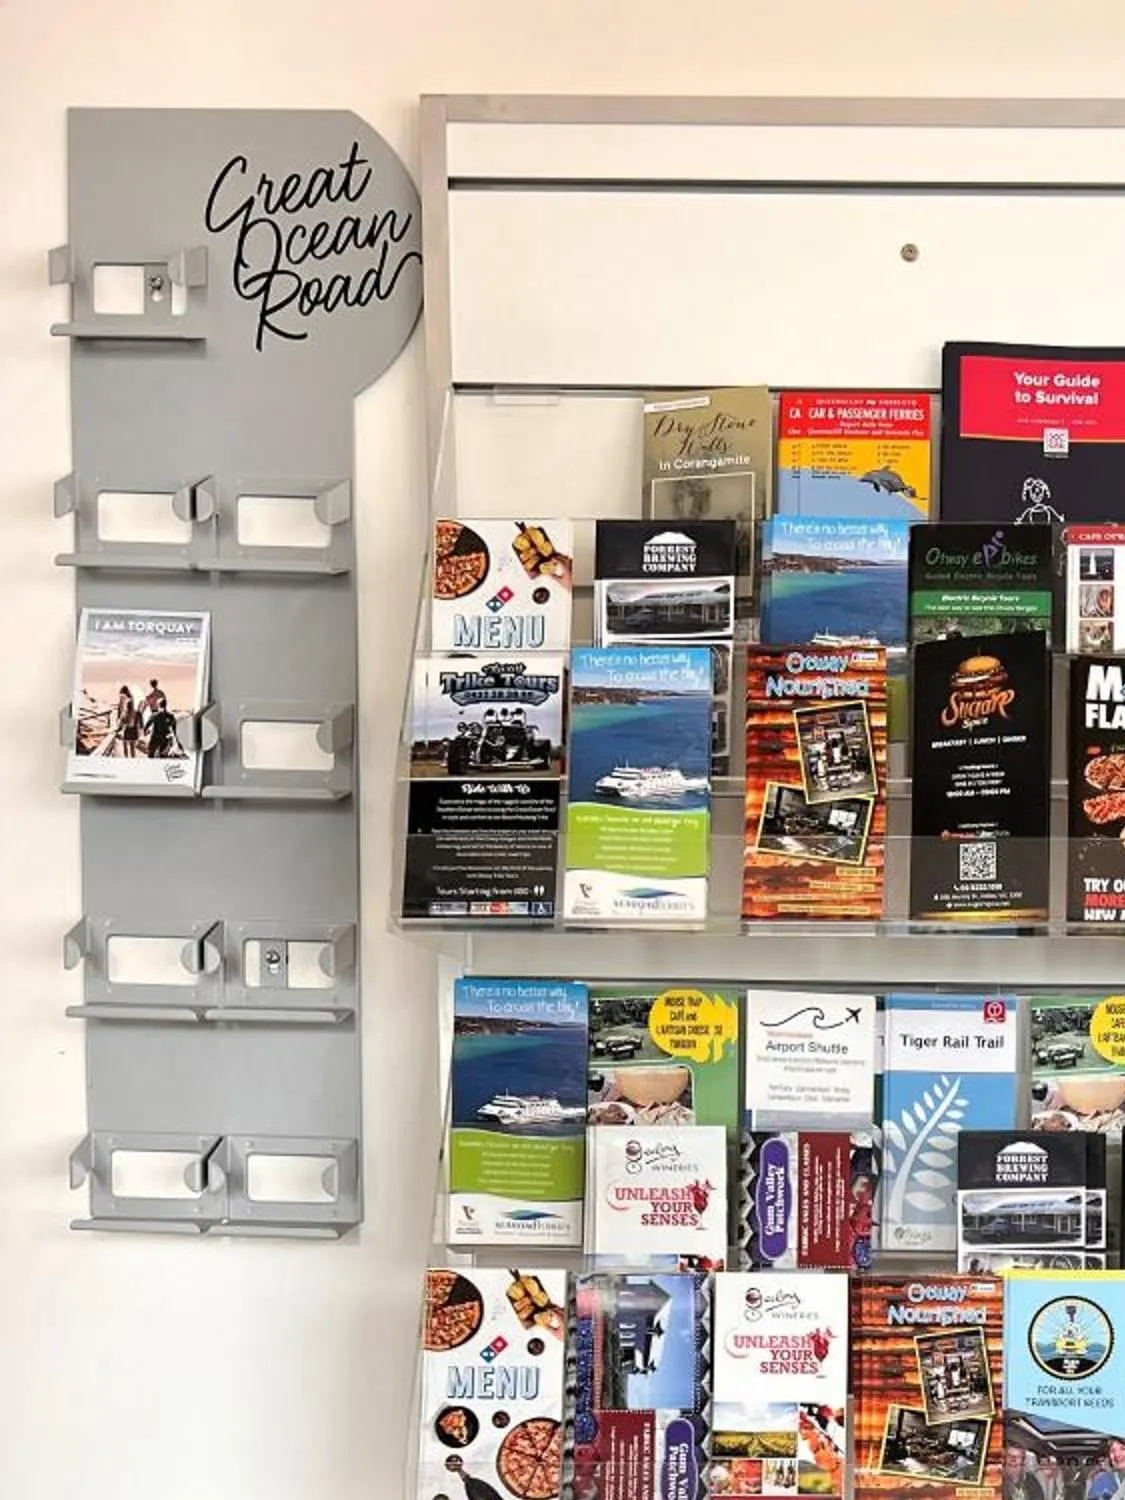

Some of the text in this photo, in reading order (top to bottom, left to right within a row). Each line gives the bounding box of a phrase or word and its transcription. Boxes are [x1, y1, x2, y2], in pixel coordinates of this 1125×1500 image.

[205, 142, 373, 233] Great
[234, 207, 413, 302] Ocean
[241, 239, 424, 353] Road
[1014, 371, 1100, 388] Your Guide
[1015, 391, 1100, 405] to Survival
[809, 408, 826, 419] CAR
[837, 408, 887, 420] PASSENGER
[889, 408, 925, 421] FERRIES
[643, 553, 698, 563] BREWING
[642, 563, 698, 573] COMPANY
[95, 621, 195, 635] I AM TORQUAY
[453, 613, 546, 649] MENU
[785, 652, 849, 674] Otway
[440, 671, 560, 694] Trike Tours
[766, 675, 870, 699] Nourished
[1083, 877, 1109, 893] TRY
[1084, 908, 1118, 921] NEW
[765, 1040, 849, 1055] Airport Shuttle
[899, 1033, 1005, 1050] Tiger Rail Trail
[996, 1163, 1048, 1173] BREWING
[995, 1172, 1049, 1183] COMPANY
[614, 1187, 693, 1201] UNLEASH
[764, 1163, 776, 1237] Gum Valley
[774, 1166, 785, 1234] Patchwork
[650, 1201, 693, 1213] YOUR
[640, 1213, 699, 1226] SENSES
[907, 1284, 967, 1303] Otway
[887, 1305, 987, 1326] Nourished
[733, 1334, 812, 1349] UNLEASH
[769, 1349, 814, 1361] YOUR
[759, 1361, 819, 1375] SENSES
[446, 1364, 541, 1401] MENU
[1037, 1385, 1056, 1395] FOR
[1083, 1398, 1115, 1408] NEEDS
[679, 1443, 689, 1475] Gum
